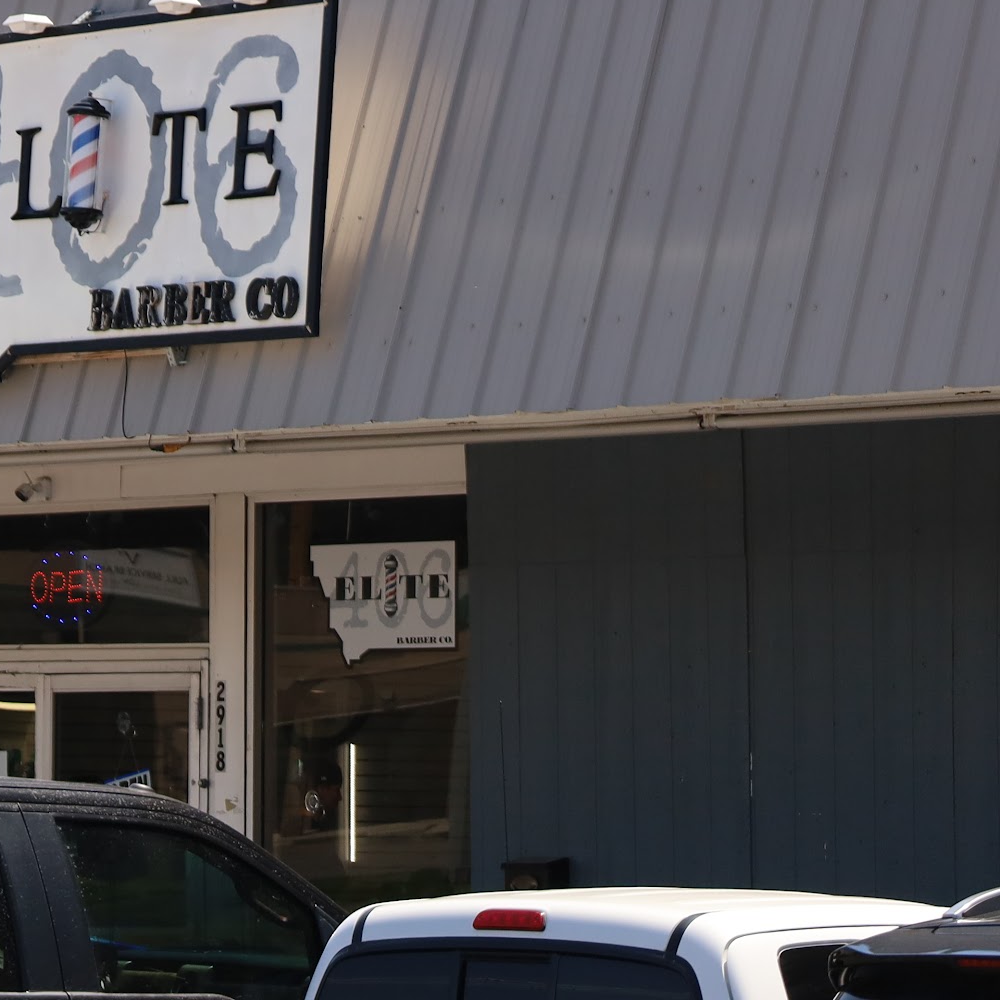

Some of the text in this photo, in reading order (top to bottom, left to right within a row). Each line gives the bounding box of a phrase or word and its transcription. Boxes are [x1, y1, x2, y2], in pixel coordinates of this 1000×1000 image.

[87, 275, 300, 331] BARBER CO
[31, 570, 103, 603] OPEN
[330, 549, 453, 628] 406
[396, 636, 437, 645] BARBER
[216, 681, 226, 771] 2918
